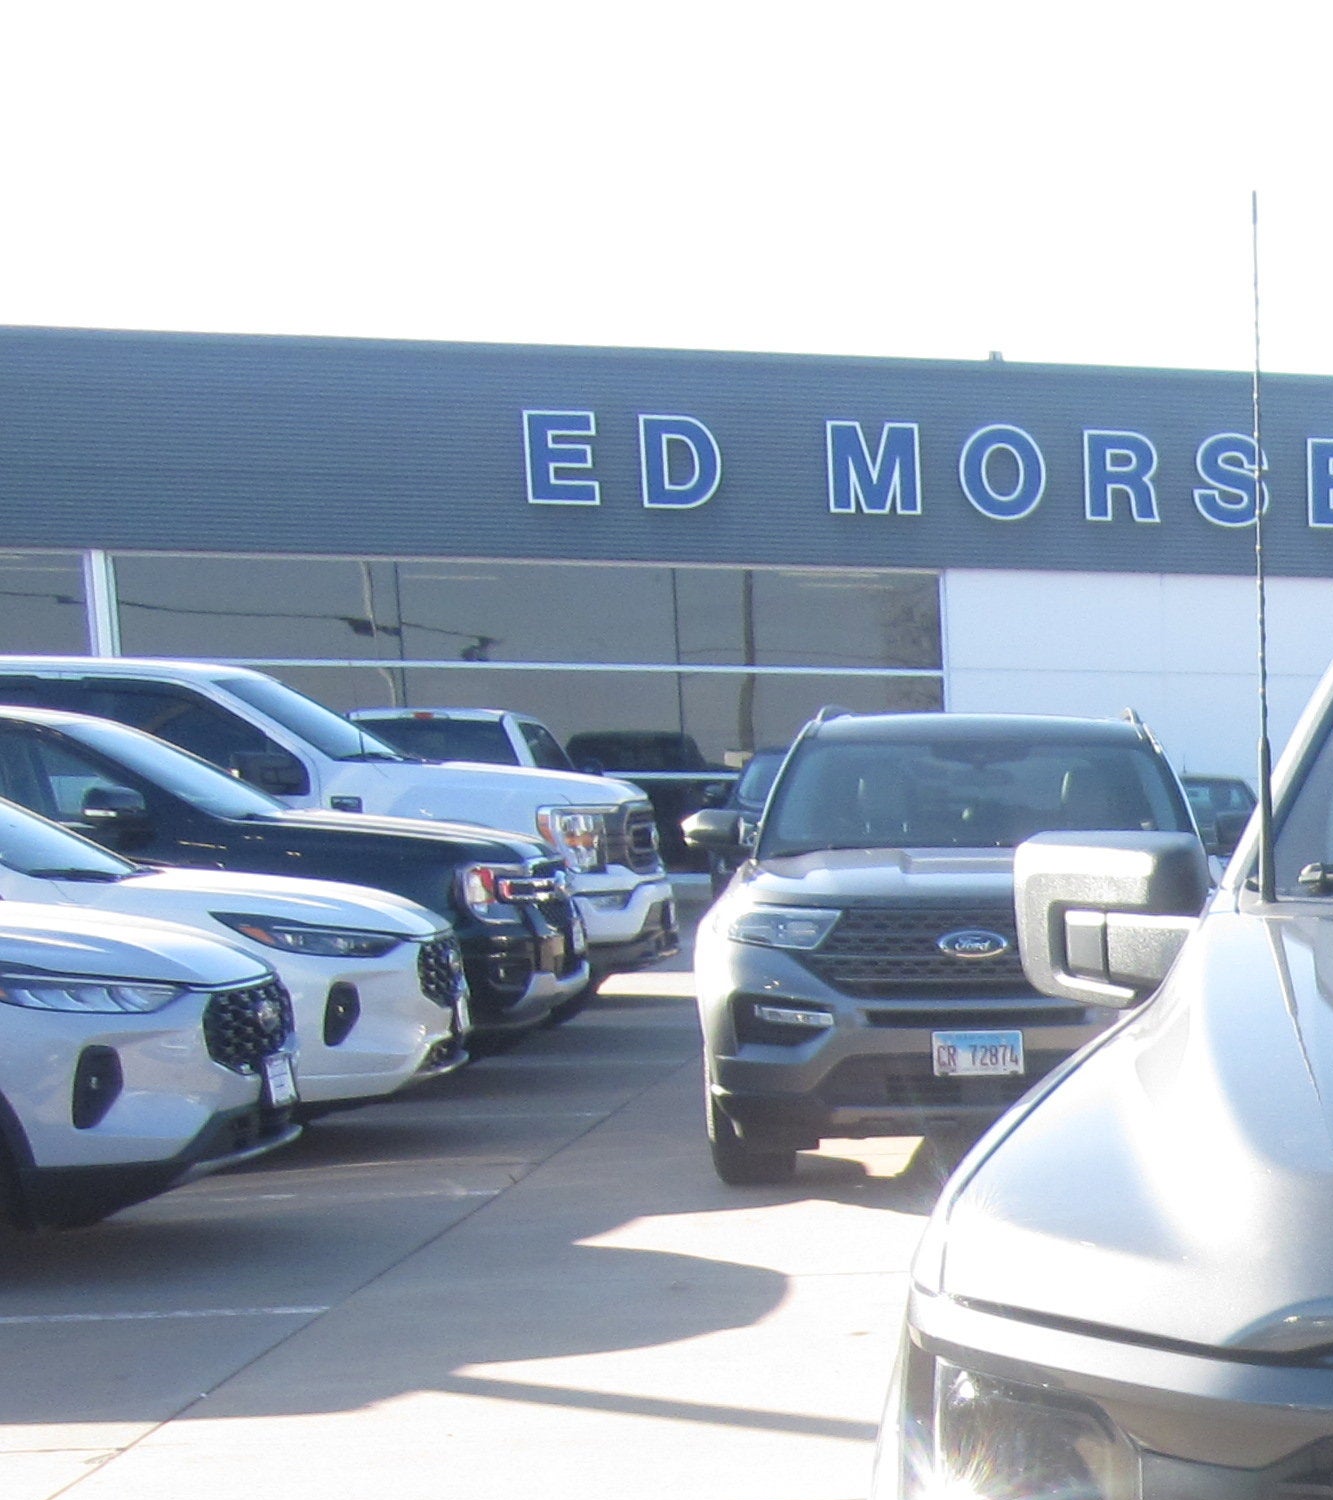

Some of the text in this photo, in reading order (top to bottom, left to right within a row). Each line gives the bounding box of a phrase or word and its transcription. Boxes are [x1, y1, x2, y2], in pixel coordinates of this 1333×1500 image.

[522, 409, 722, 508] ED
[937, 1045, 1019, 1067] CR 72874
